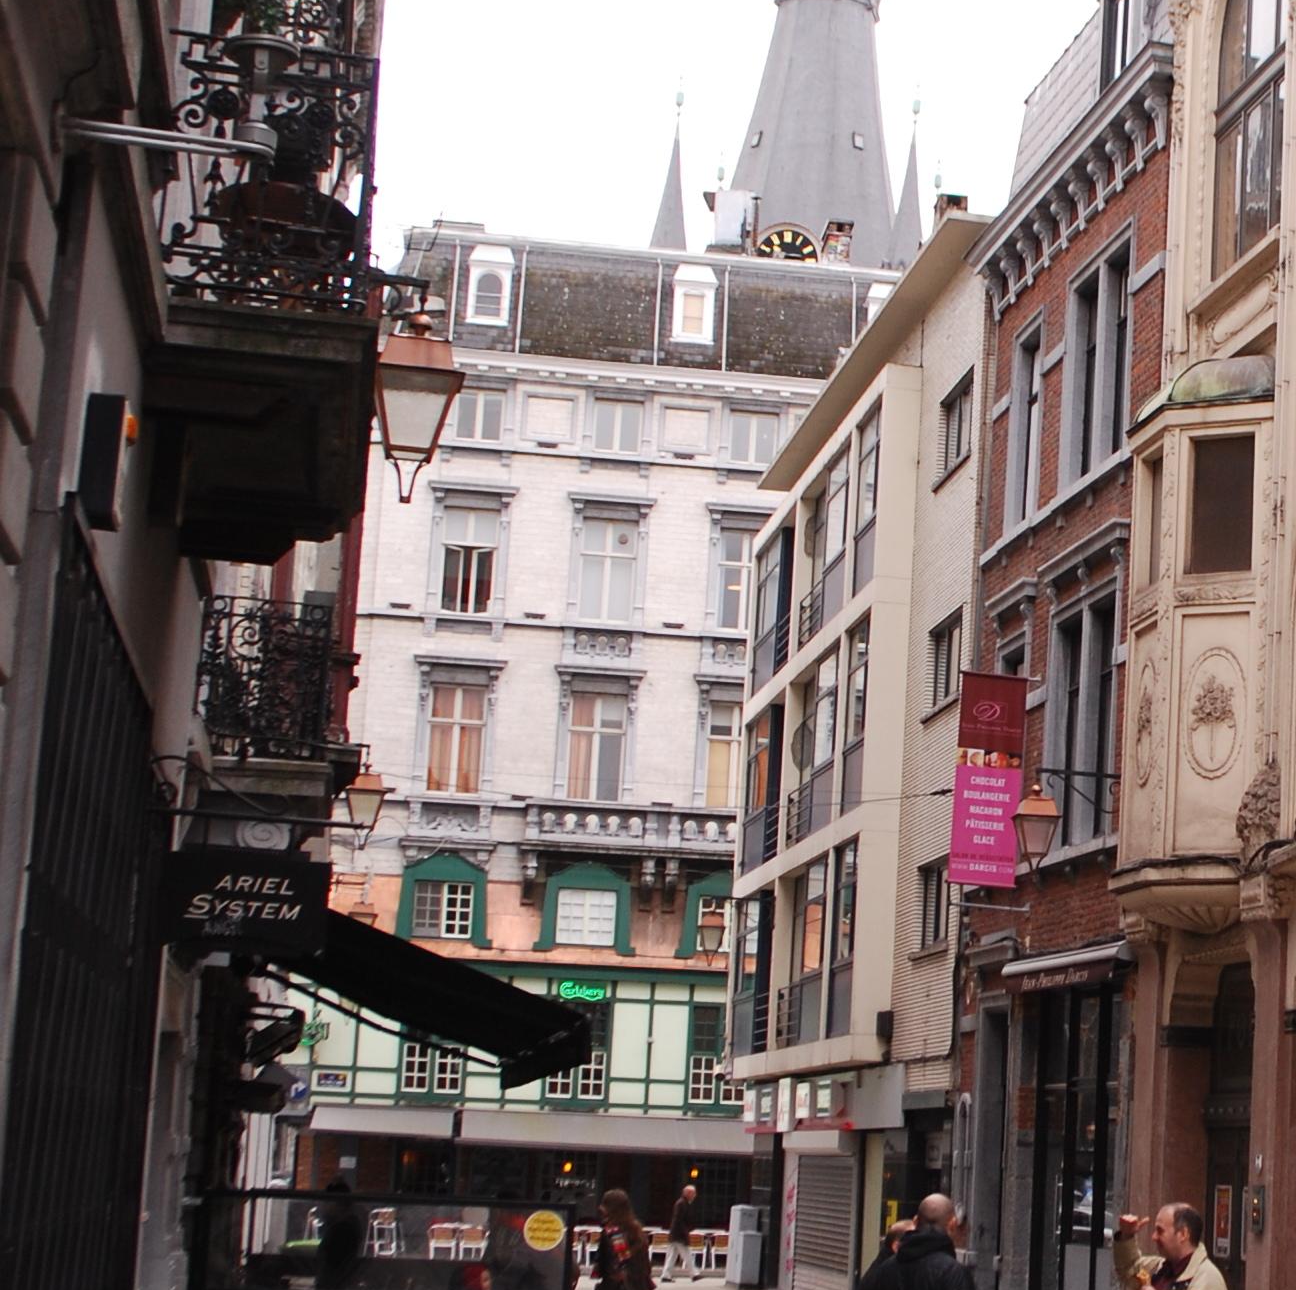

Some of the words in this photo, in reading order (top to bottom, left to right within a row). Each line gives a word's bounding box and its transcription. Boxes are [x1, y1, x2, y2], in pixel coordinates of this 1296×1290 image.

[970, 775, 1006, 788] CHOCOLAT
[963, 789, 1011, 803] BOULANGERIE
[969, 804, 1004, 816] MACARON
[973, 835, 995, 846] GLACE
[214, 874, 296, 896] ARIEL
[183, 894, 304, 921] SYSTEM
[559, 981, 605, 1001] Carlsberg
